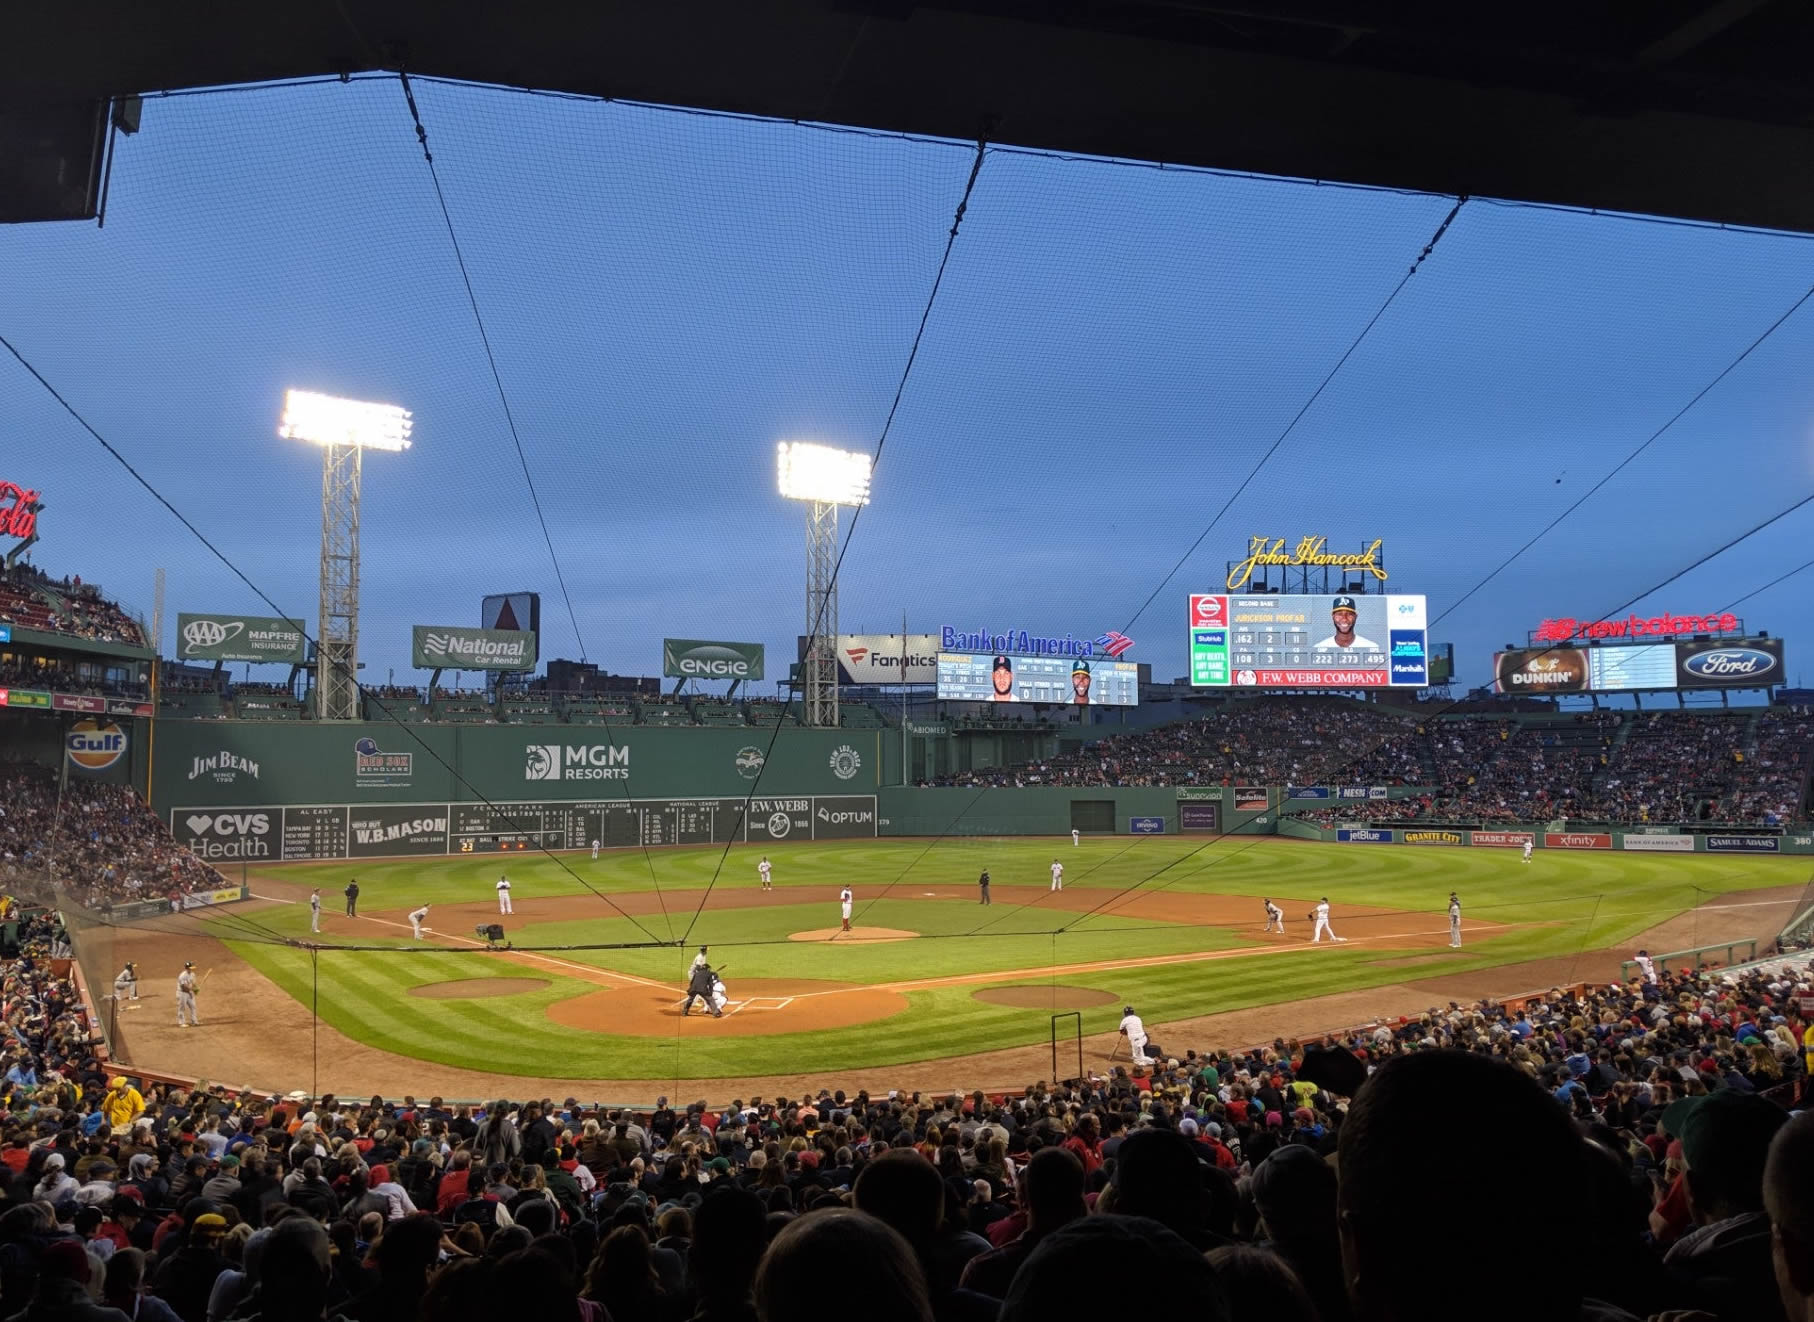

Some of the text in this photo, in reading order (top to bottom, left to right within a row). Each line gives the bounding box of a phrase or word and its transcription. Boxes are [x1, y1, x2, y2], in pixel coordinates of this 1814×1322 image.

[1227, 535, 1388, 589] John Hancock
[1579, 612, 1737, 638] new balance
[189, 622, 220, 644] AAA
[248, 630, 300, 641] MAPFRE
[941, 624, 1094, 660] Bank of America
[1235, 635, 1253, 644] .162
[1267, 635, 1273, 643] 2
[251, 642, 297, 650] INSURANCE
[448, 637, 524, 656] National
[475, 656, 521, 664] Car Rental
[871, 653, 936, 667] Fanatics
[1236, 655, 1385, 664] 108 3 0 .222 .273 .495
[1702, 653, 1757, 674] Ford
[1262, 673, 1384, 683] F.W. WEBB COMPANY
[1512, 672, 1572, 684] DUNKIN'
[912, 726, 947, 734] ABIOMED
[70, 734, 122, 751] Gulf
[565, 745, 629, 766] MGM
[188, 751, 259, 780] JIM BEAM
[565, 768, 629, 780] RESORTS
[1236, 793, 1266, 801] Safelite
[1343, 788, 1366, 797] NESN
[751, 800, 808, 813] F.W. WEBB
[831, 811, 872, 824] OPTUM
[213, 813, 270, 836] CVS
[750, 821, 765, 829] Since
[356, 818, 447, 844] W.B.MASON
[1349, 830, 1380, 842] jetBlue
[1405, 832, 1461, 843] GRANITE CITY
[1474, 835, 1506, 843] TRADER
[1560, 834, 1597, 847] xfinity
[1710, 838, 1775, 847] SAMUEL ADAMS
[1793, 837, 1812, 845] 380
[189, 836, 270, 858] Health
[462, 842, 473, 852] 23
